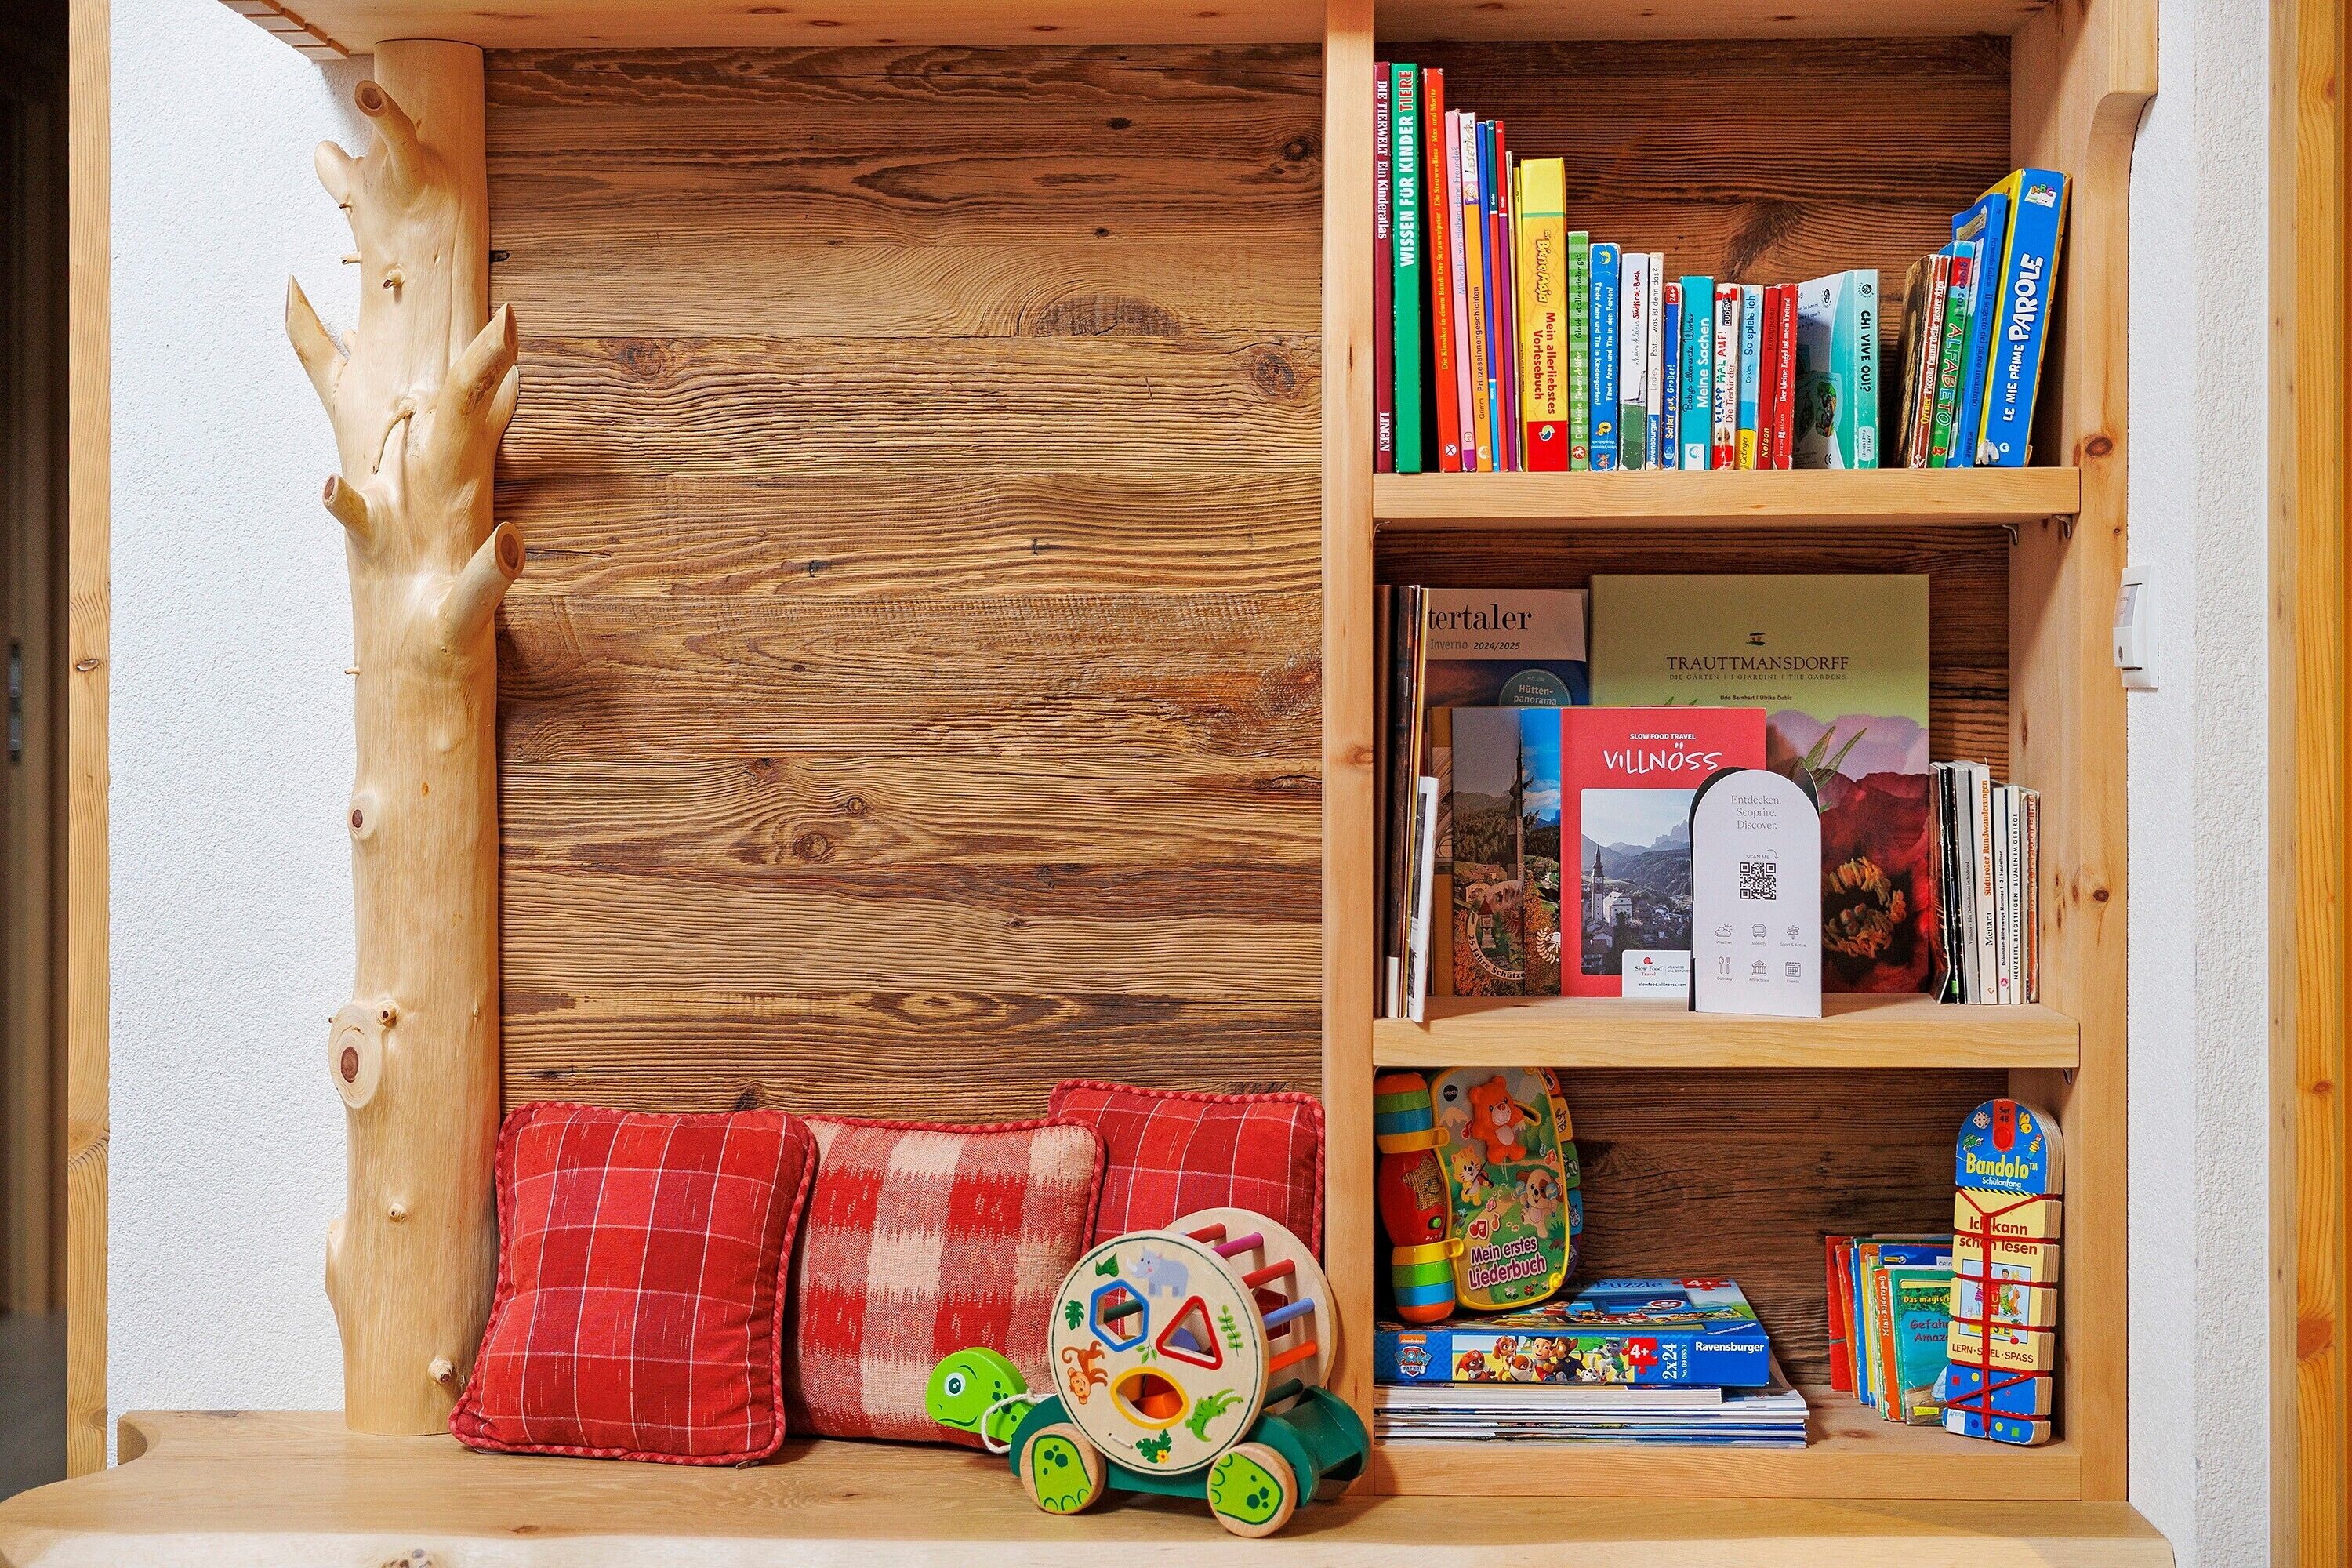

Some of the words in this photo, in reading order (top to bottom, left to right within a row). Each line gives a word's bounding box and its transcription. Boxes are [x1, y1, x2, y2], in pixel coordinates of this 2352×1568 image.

[1377, 80, 1387, 100] DIE
[1399, 70, 1414, 113] TIERE
[1377, 103, 1388, 156] TIERWELT
[1399, 115, 1414, 173] KINDER
[1377, 161, 1388, 176] Ein
[1432, 148, 1440, 193] Struwwelliese
[1450, 146, 1461, 184] Freunde?
[1399, 176, 1414, 206] FÜR
[1453, 186, 1461, 208] deine
[2031, 183, 2055, 197] ABC
[1377, 177, 1388, 240] Kinderatlas
[1399, 209, 1414, 267] WISSEN
[1434, 212, 1443, 260] Struwwelpeter
[1454, 210, 1463, 240] bleiben
[1536, 238, 1551, 270] Biene
[1536, 271, 1551, 303] Maja
[1958, 261, 1969, 289] gioco
[1632, 270, 1641, 319] Südtirol-Buch
[1746, 295, 1755, 309] ich
[2008, 252, 2044, 341] PAROLE
[1546, 312, 1555, 342] Mein
[1574, 318, 1583, 339] Gleich
[1745, 312, 1755, 339] spiele
[1860, 310, 1871, 330] CHI
[1978, 300, 1991, 329] segreto
[1439, 327, 1448, 357] Klassiker
[1472, 286, 1484, 392] Prinzessinnengeschichten
[1697, 318, 1709, 365] Sachen
[1717, 331, 1726, 358] AUF!
[1860, 334, 1871, 361] VIVE
[1533, 330, 1544, 400] Vorlesebuch
[1632, 345, 1640, 364] Mein
[1683, 345, 1693, 383] allererste
[1780, 350, 1791, 368] Engel
[1974, 346, 1984, 368] parco
[2009, 344, 2024, 379] PRIME
[1546, 345, 1557, 415] allerliebstes
[1593, 358, 1602, 405] Kindergarten!
[1666, 365, 1675, 394] Großer!
[1716, 360, 1726, 383] MAL
[1726, 364, 1734, 406] Tierkinder
[1860, 365, 1871, 393] QUI?
[1924, 367, 1934, 395] Piccola
[1936, 323, 1962, 426] ALFABETO
[1682, 386, 1693, 412] Babys
[1697, 368, 1709, 408] Meine
[1971, 370, 1982, 407] incantato
[2005, 382, 2017, 403] MIE
[1667, 395, 1675, 411] gut,
[2003, 408, 2015, 422] LE
[1380, 412, 1390, 452] LINGEN
[1760, 427, 1769, 458] Nelson
[1740, 436, 1749, 465] Oetinger
[1428, 604, 1533, 630] tertaler
[1431, 639, 1468, 650] Inverno
[1473, 642, 1520, 651] 2024/2025
[1667, 656, 1849, 670] TRAUTTMANSDORFF
[1513, 695, 1557, 706] panorama
[1519, 684, 1554, 695] Hütten-
[1731, 795, 1782, 804] Entdecken.
[1737, 808, 1777, 818] Scoprire.
[1737, 820, 1777, 829] Discover.
[1981, 780, 1991, 854] Rundwanderungen
[2013, 846, 2018, 855] IM
[1983, 856, 1991, 896] Südtiroler
[1984, 912, 1993, 946] Menara
[1468, 935, 1476, 946] 25
[1472, 948, 1490, 969] Jahre
[1999, 1106, 2010, 1115] Set
[1982, 1176, 2022, 1189] Schulanfang
[1992, 1219, 2028, 1236] kann
[1471, 1245, 1501, 1265] Mein
[1504, 1237, 1537, 1257] erstes
[1959, 1236, 1997, 1250] schn
[2002, 1240, 2038, 1255] lesen
[1468, 1253, 1546, 1289] Liederbuch
[1596, 1281, 1662, 1290] Puzzle
[1878, 1276, 1889, 1337] Mini-Bilderspaß
[1394, 1350, 1432, 1366] PAW
[1630, 1344, 1649, 1359] 4+
[1662, 1342, 1677, 1380] 2x24
[1695, 1341, 1765, 1354] Ravensburger
[1952, 1343, 1973, 1354] LERN
[1977, 1347, 2000, 1358] SEL
[2005, 1351, 2034, 1363] SPASS
